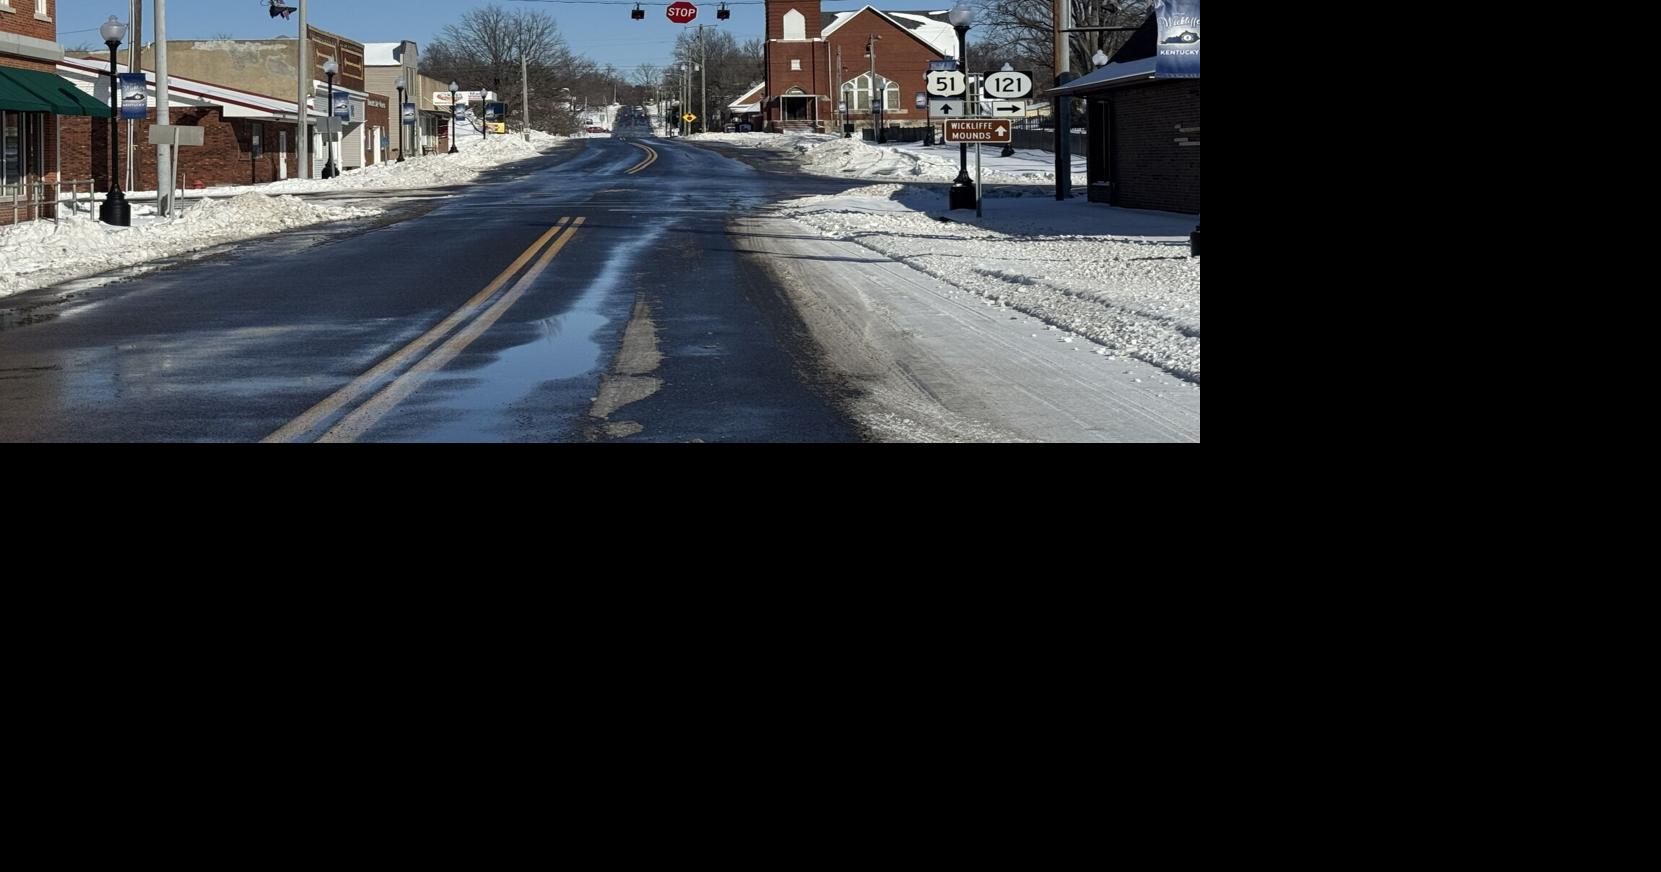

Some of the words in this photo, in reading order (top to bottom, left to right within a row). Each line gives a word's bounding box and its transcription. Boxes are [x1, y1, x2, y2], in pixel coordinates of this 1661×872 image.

[668, 7, 696, 17] STOP
[936, 77, 955, 92] 51
[994, 77, 1021, 93] 121
[950, 122, 993, 130] WICKLIFFE
[952, 132, 991, 140] MOUNDS
